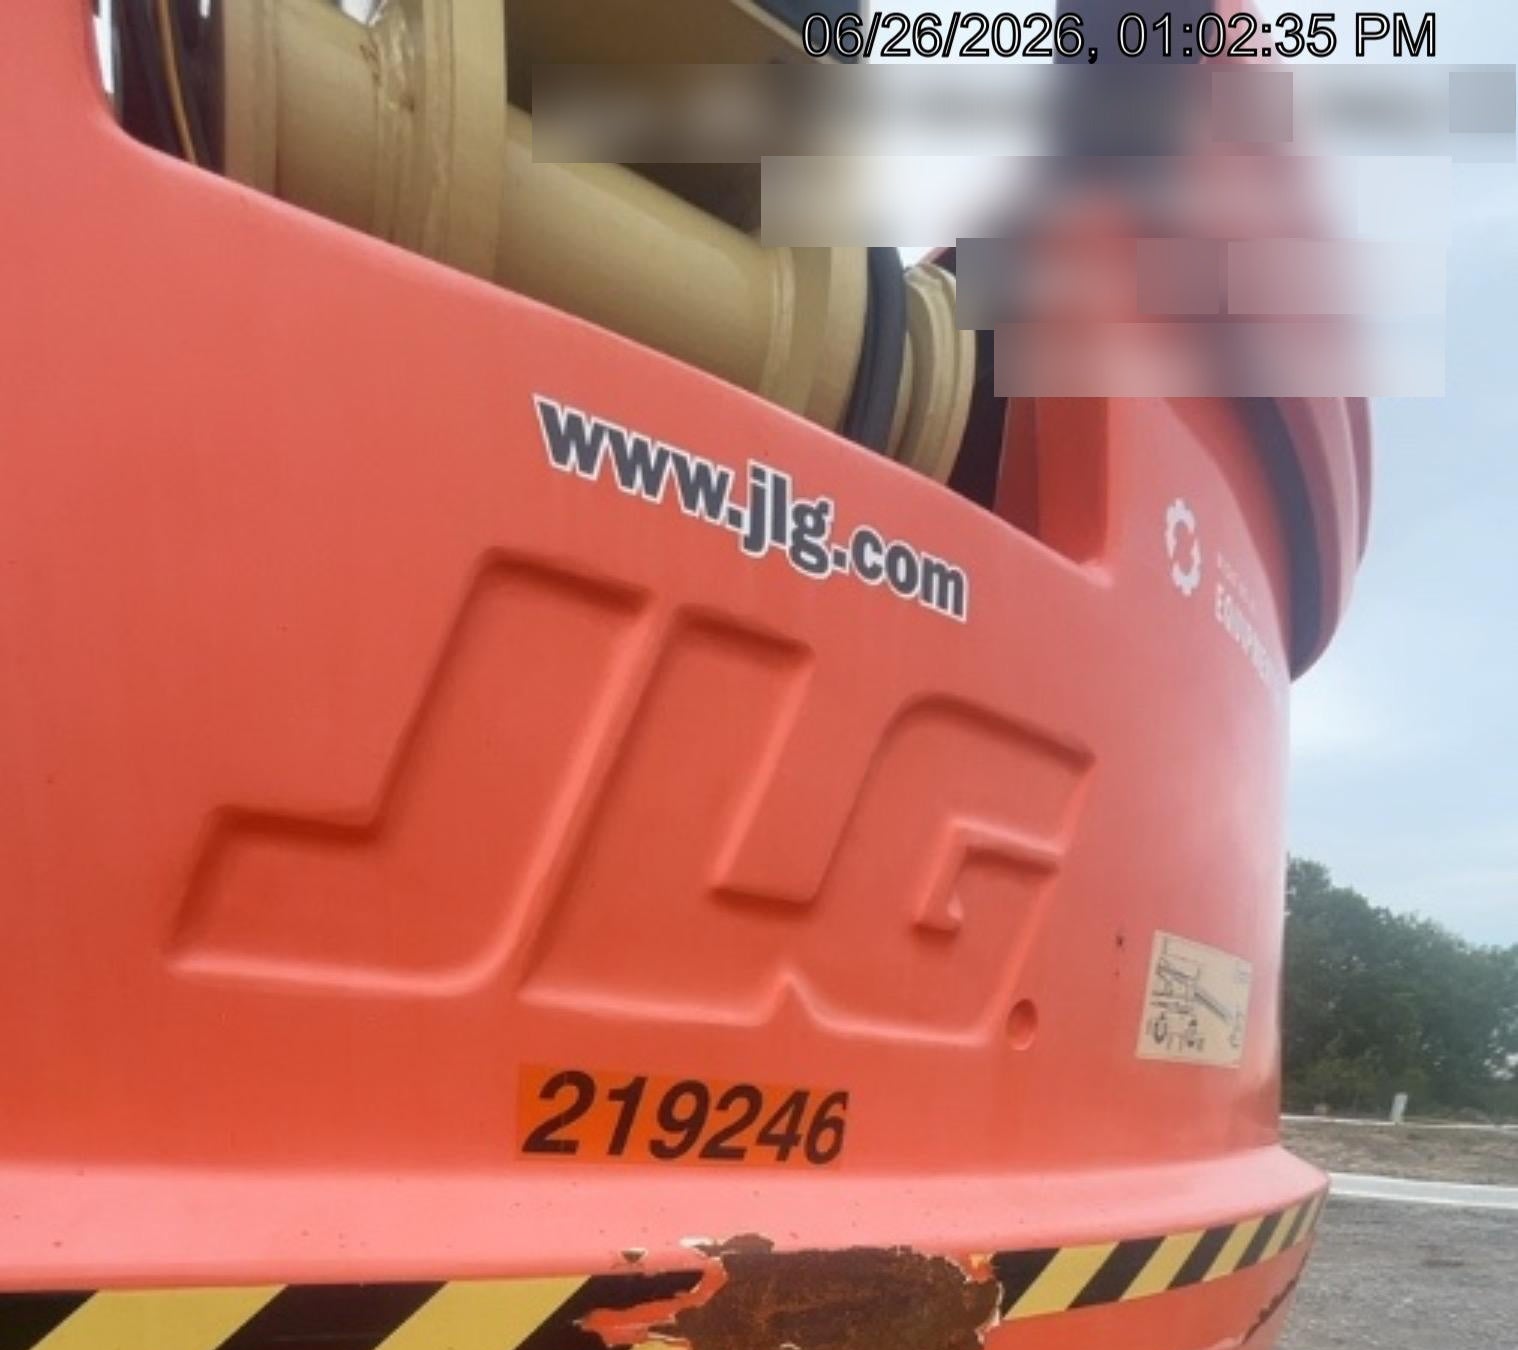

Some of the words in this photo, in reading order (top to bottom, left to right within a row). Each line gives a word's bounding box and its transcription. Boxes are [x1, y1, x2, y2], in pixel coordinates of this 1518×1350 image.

[533, 394, 968, 623] www.jlg.com
[166, 545, 1095, 1047] JLG
[521, 1070, 849, 1165] 219246
